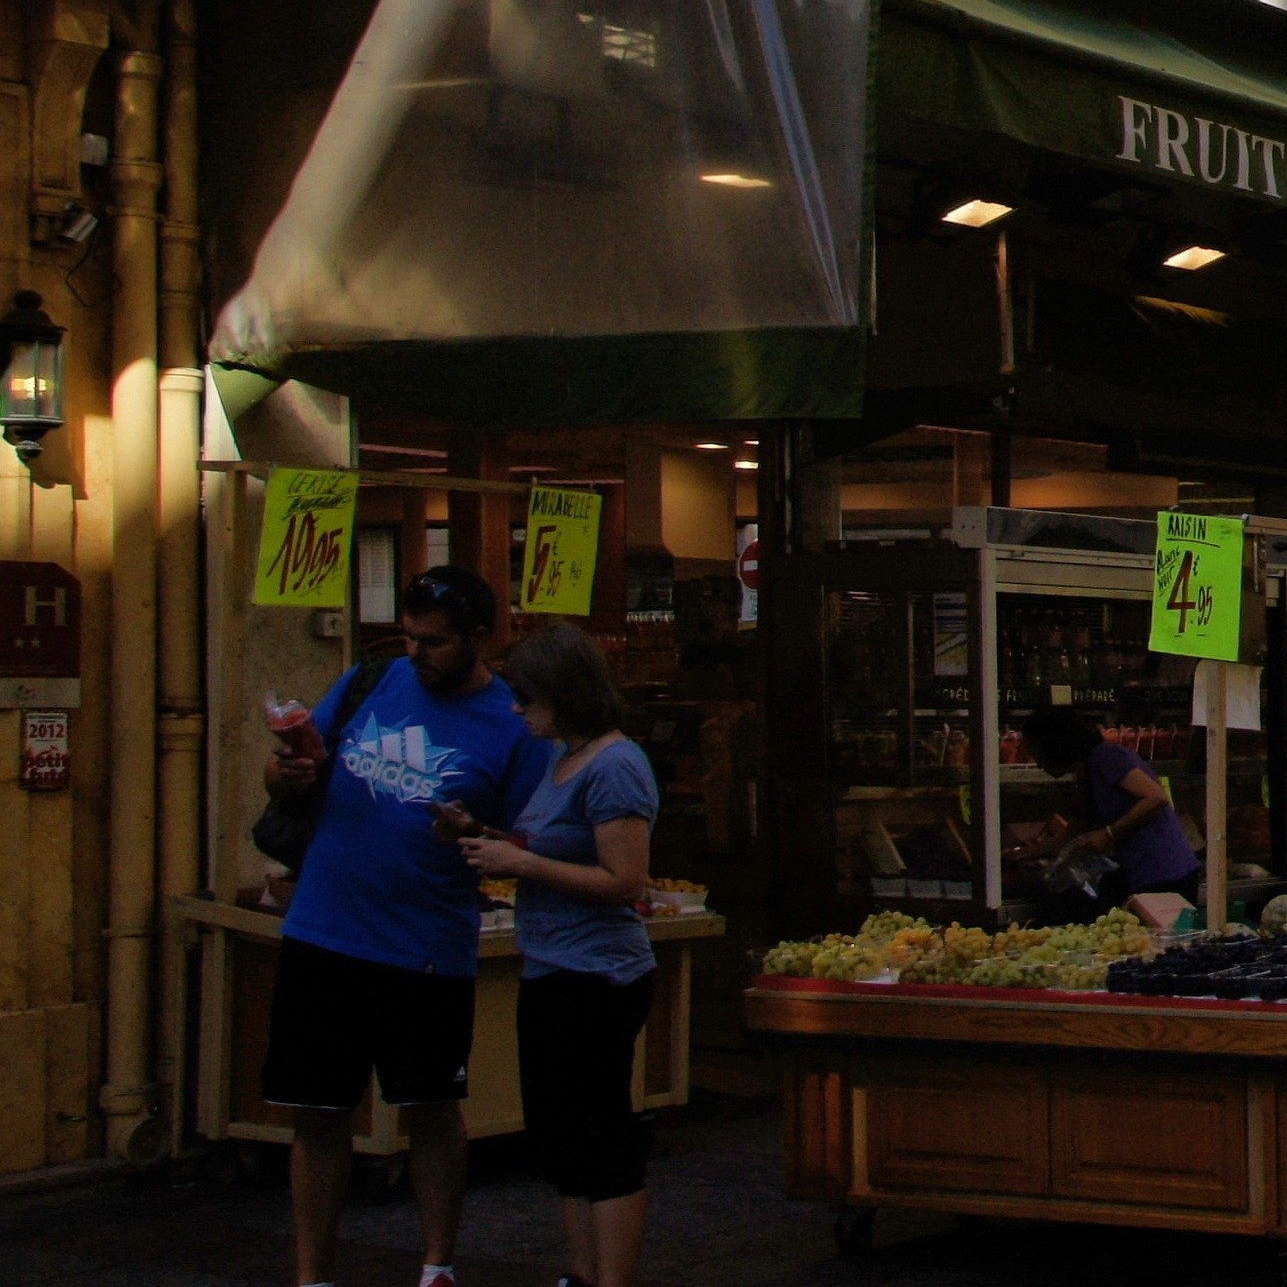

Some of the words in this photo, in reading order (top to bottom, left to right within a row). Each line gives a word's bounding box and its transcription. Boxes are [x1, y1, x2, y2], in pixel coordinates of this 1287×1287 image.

[1167, 514, 1207, 541] RAISIN
[24, 585, 68, 626] H
[28, 723, 65, 739] 2012
[341, 749, 444, 799] adidas
